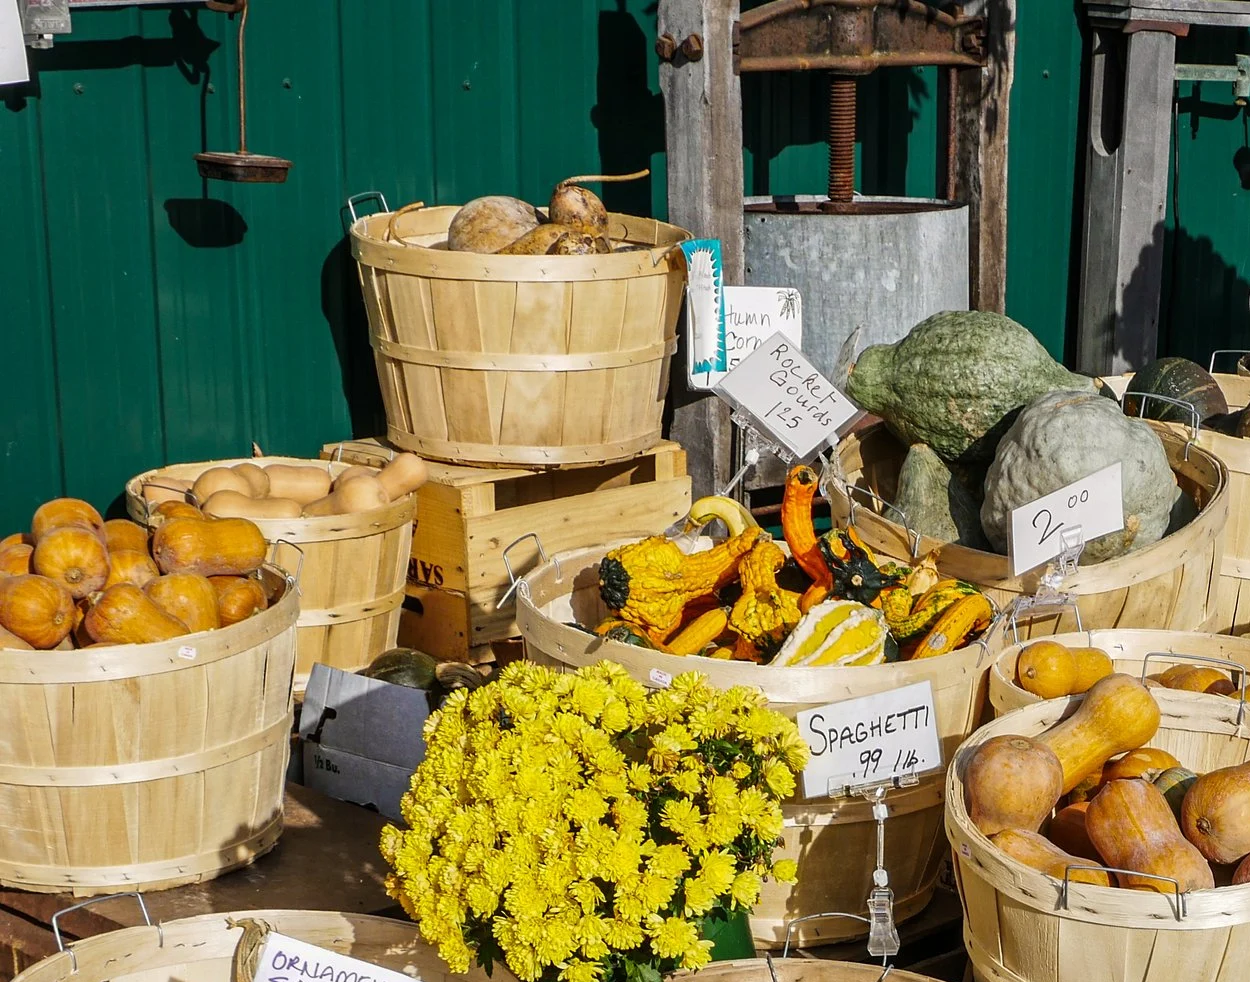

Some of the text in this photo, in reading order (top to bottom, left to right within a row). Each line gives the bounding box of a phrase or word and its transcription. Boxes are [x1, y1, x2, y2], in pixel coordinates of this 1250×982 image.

[770, 370, 832, 426] Gourds
[809, 705, 929, 756] SPAGHETTI
[325, 758, 341, 775] Bu.
